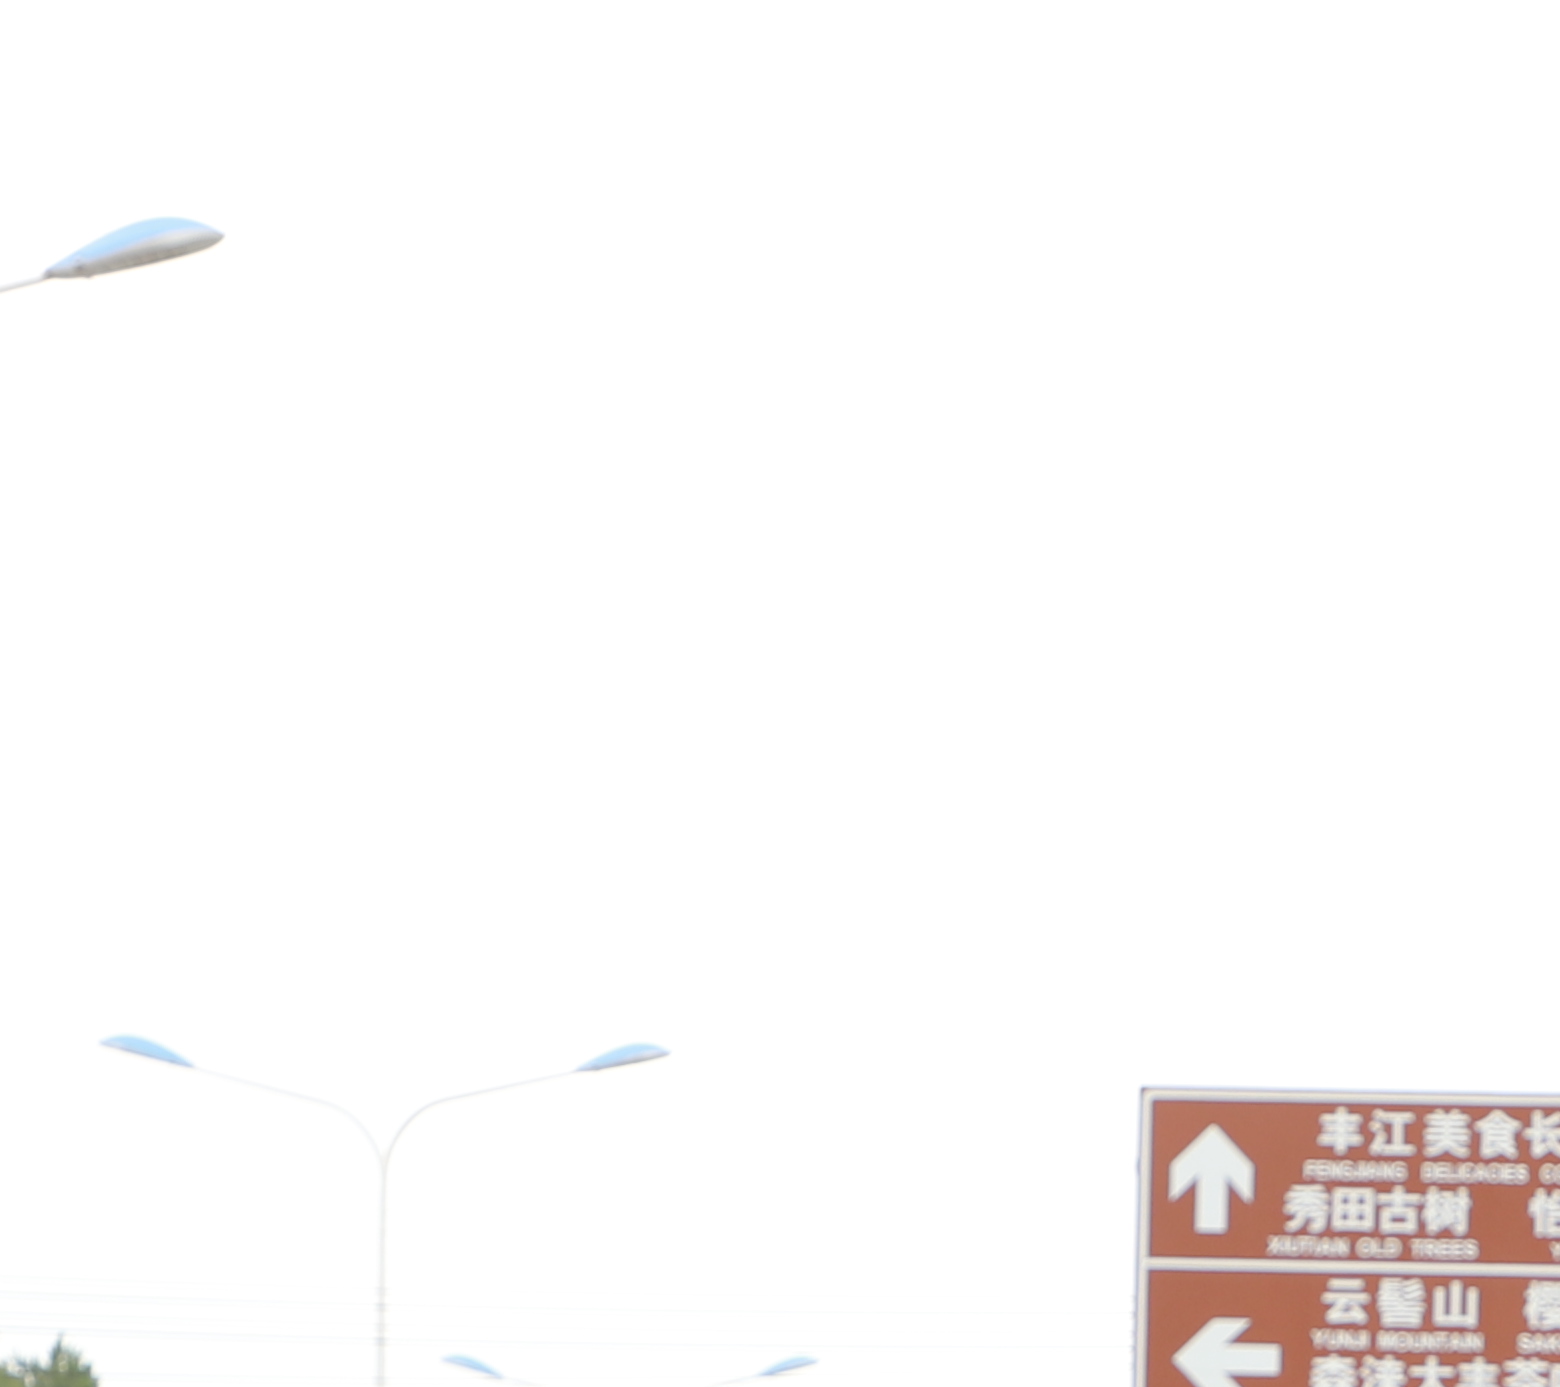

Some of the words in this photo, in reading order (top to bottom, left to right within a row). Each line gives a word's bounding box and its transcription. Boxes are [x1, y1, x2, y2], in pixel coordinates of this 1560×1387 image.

[1282, 1183, 1474, 1237] 秀田古树
[1354, 1236, 1403, 1259] OLD
[1409, 1238, 1480, 1261] TREES
[1375, 1329, 1485, 1354] MOUNTAIN
